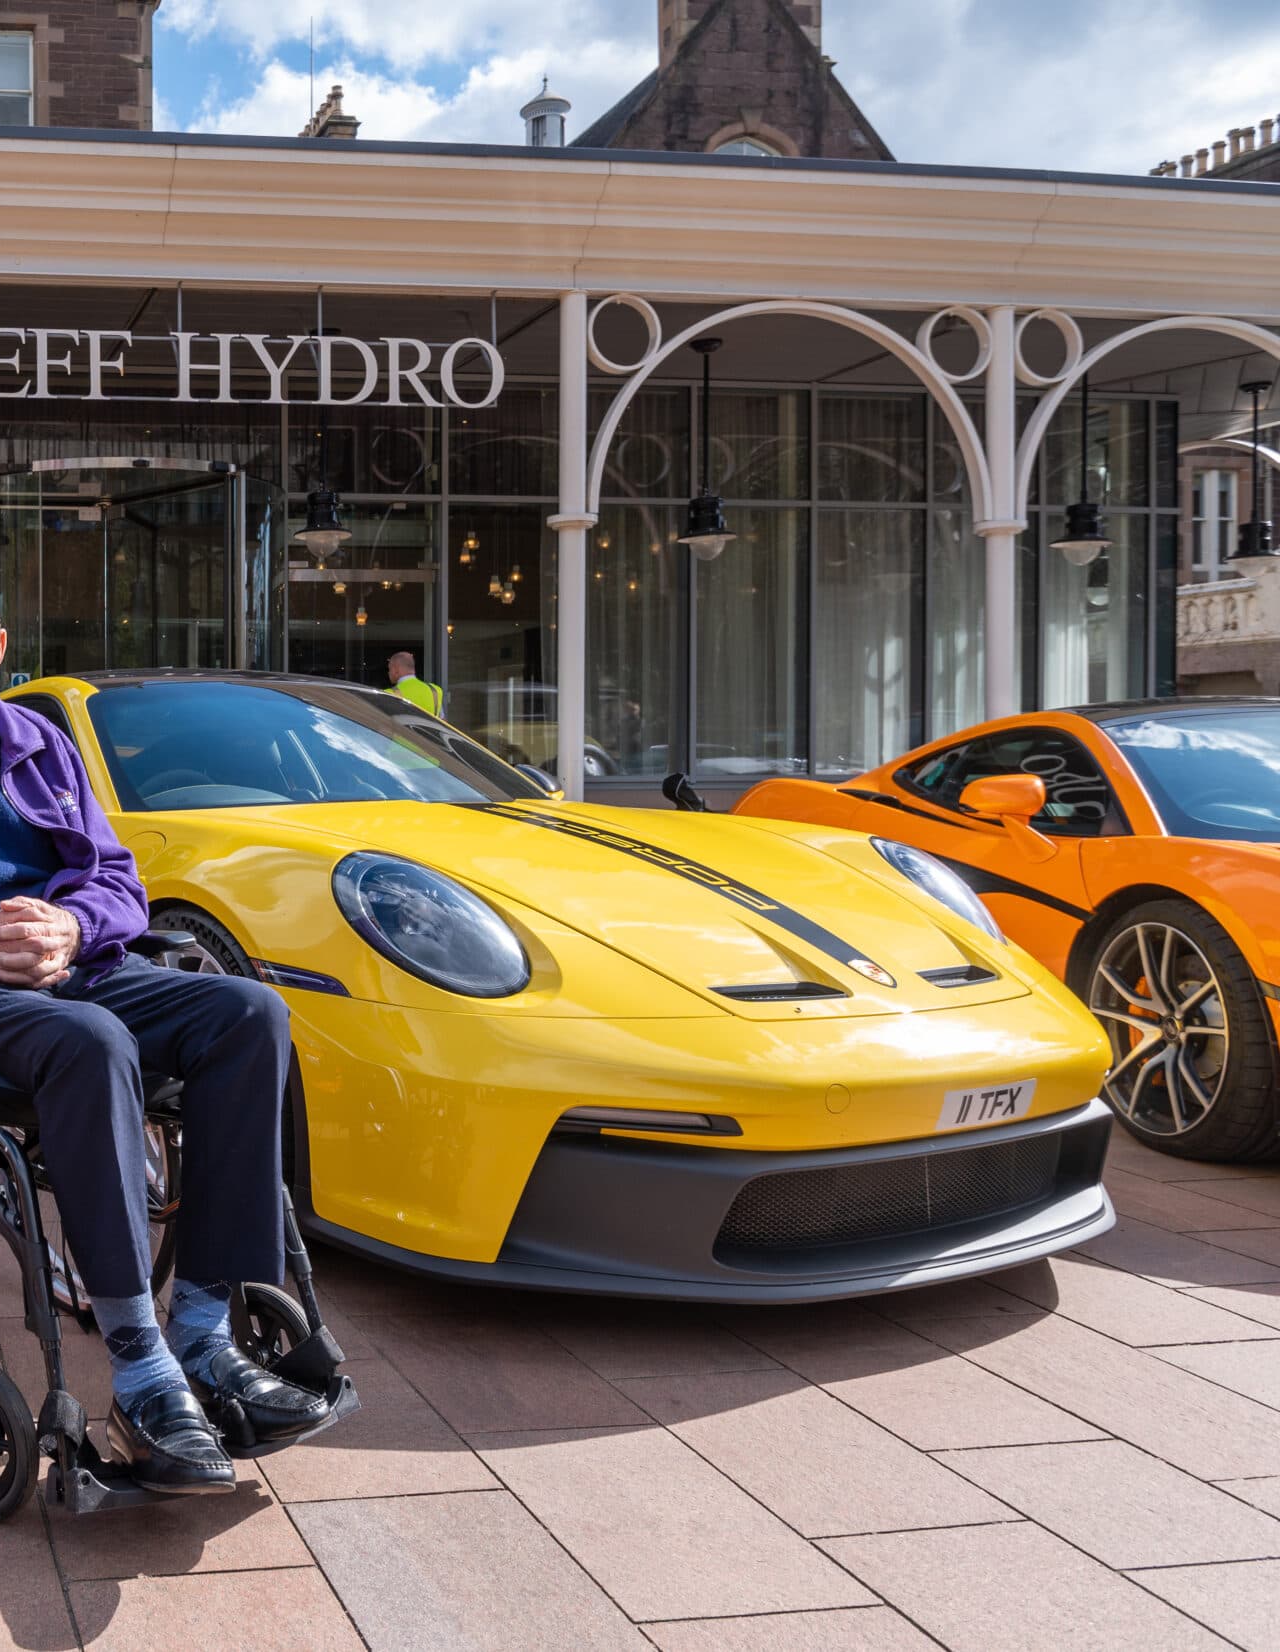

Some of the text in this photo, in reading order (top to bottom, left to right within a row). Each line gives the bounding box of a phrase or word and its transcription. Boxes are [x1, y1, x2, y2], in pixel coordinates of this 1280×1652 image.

[170, 332, 505, 408] HYDRO
[483, 807, 780, 910] PORSCHE
[955, 1086, 1023, 1124] 11 TFX
